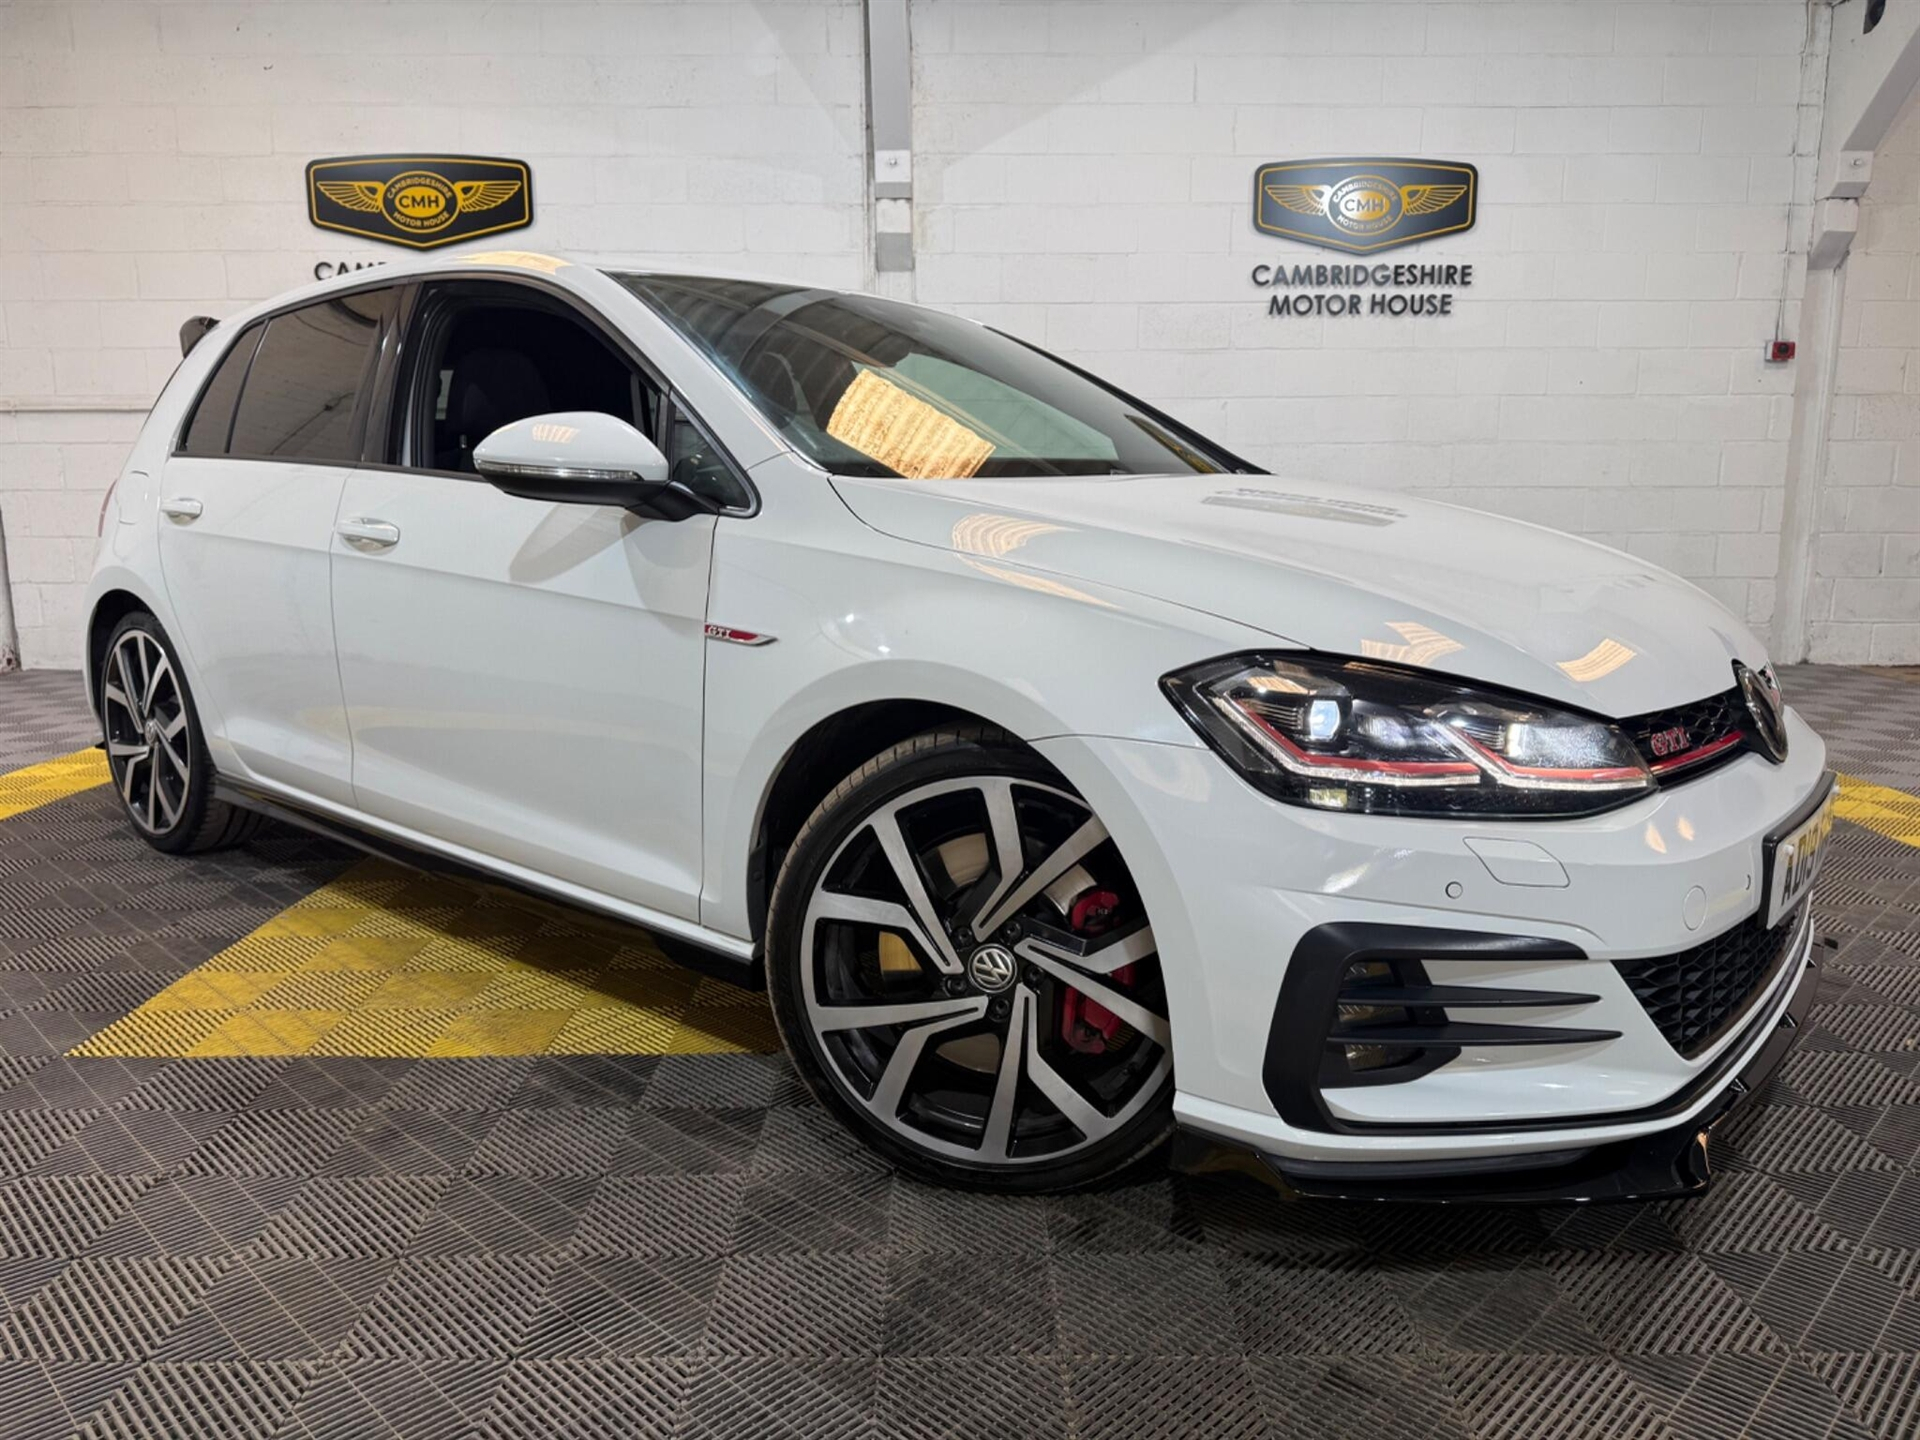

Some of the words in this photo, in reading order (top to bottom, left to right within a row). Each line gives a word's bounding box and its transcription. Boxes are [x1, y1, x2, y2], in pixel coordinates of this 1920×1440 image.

[387, 177, 453, 199] CAMBRIDGESHIRE
[399, 195, 440, 209] CMH
[1344, 197, 1386, 212] CMH
[393, 212, 422, 227] MOTOR
[423, 213, 450, 227] HOUSE
[1337, 215, 1365, 230] MOTOR
[1366, 216, 1393, 230] HOUSE
[1252, 263, 1473, 287] CAMBRIDGESHIRE
[1269, 294, 1361, 316] MOTOR
[1371, 294, 1453, 316] HOUSE
[708, 625, 730, 639] GTI
[1651, 726, 1690, 757] GTI
